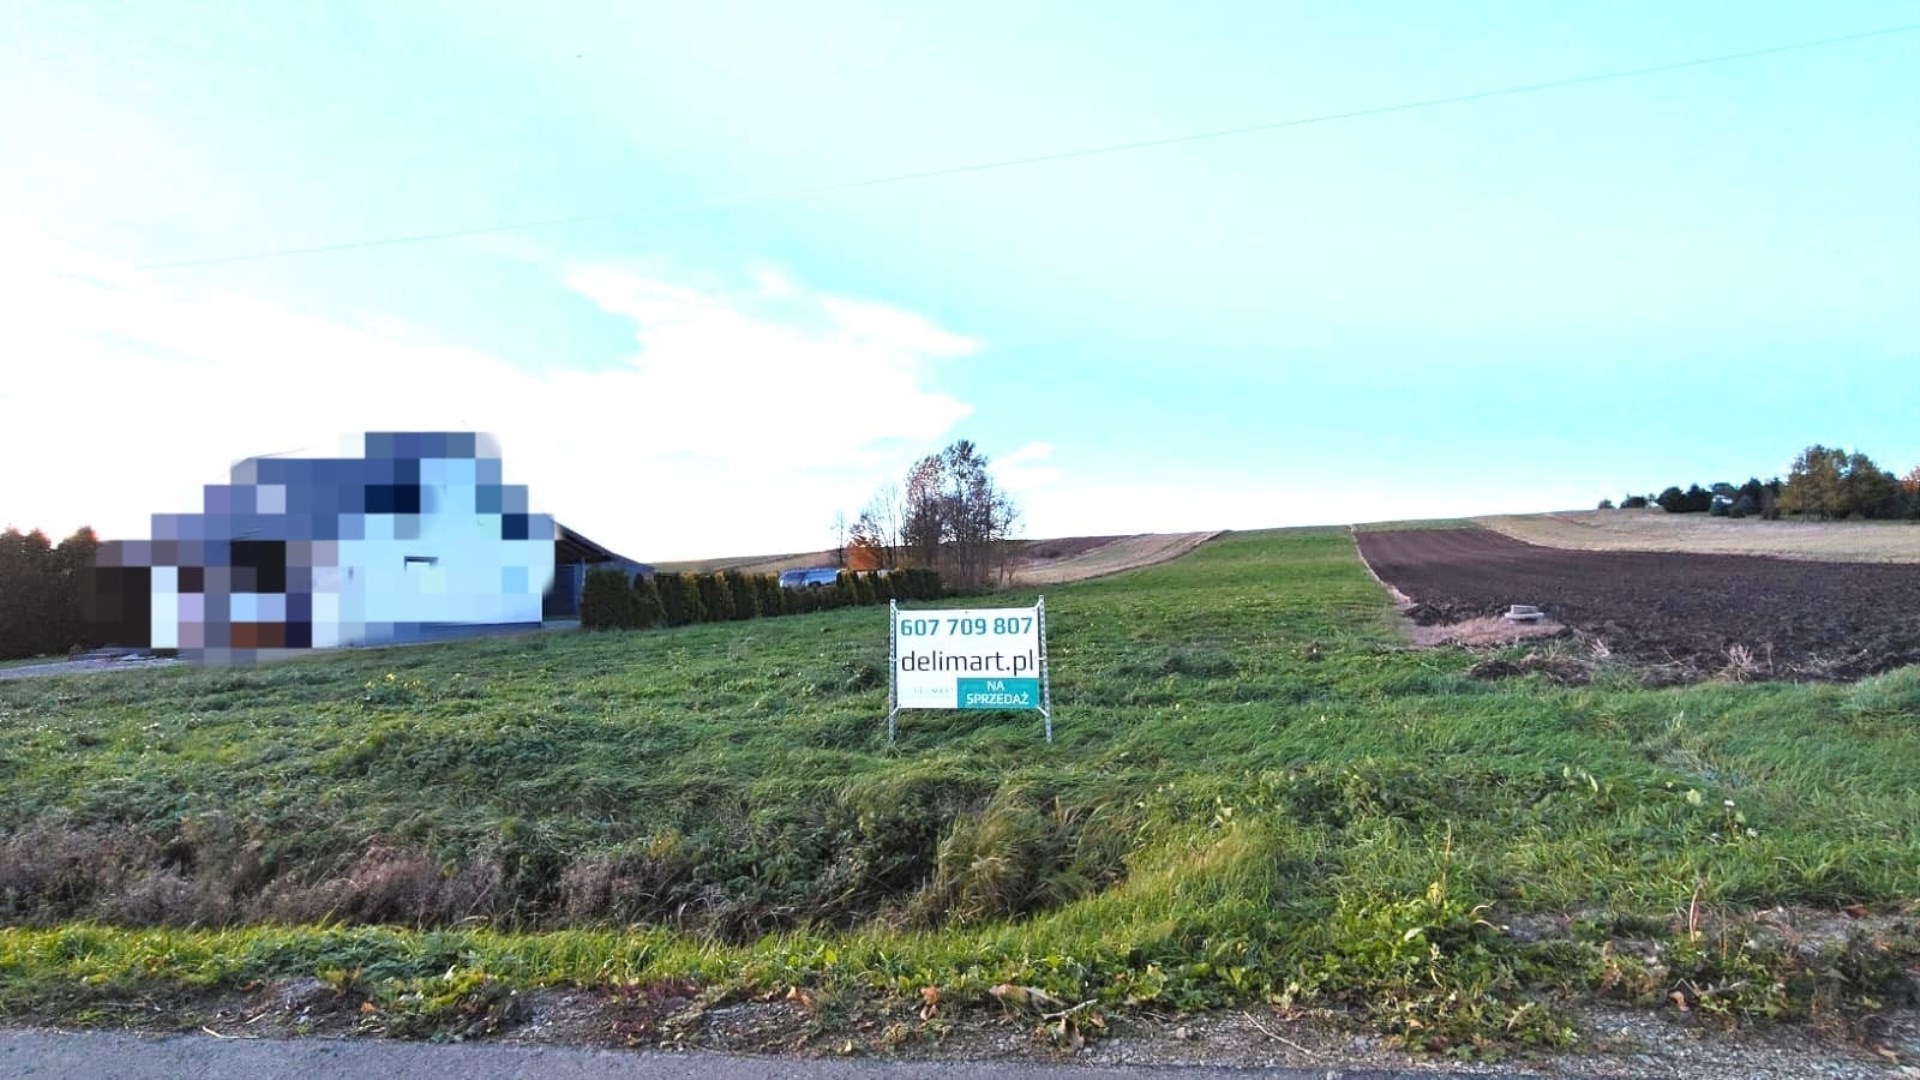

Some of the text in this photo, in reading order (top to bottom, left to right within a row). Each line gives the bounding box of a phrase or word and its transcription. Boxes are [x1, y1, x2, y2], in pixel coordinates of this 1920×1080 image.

[901, 617, 1033, 636] 607 709 807
[902, 649, 1034, 676] delimart.pl
[987, 681, 1005, 691] NA
[966, 691, 1029, 704] SPRZEDAŻ
